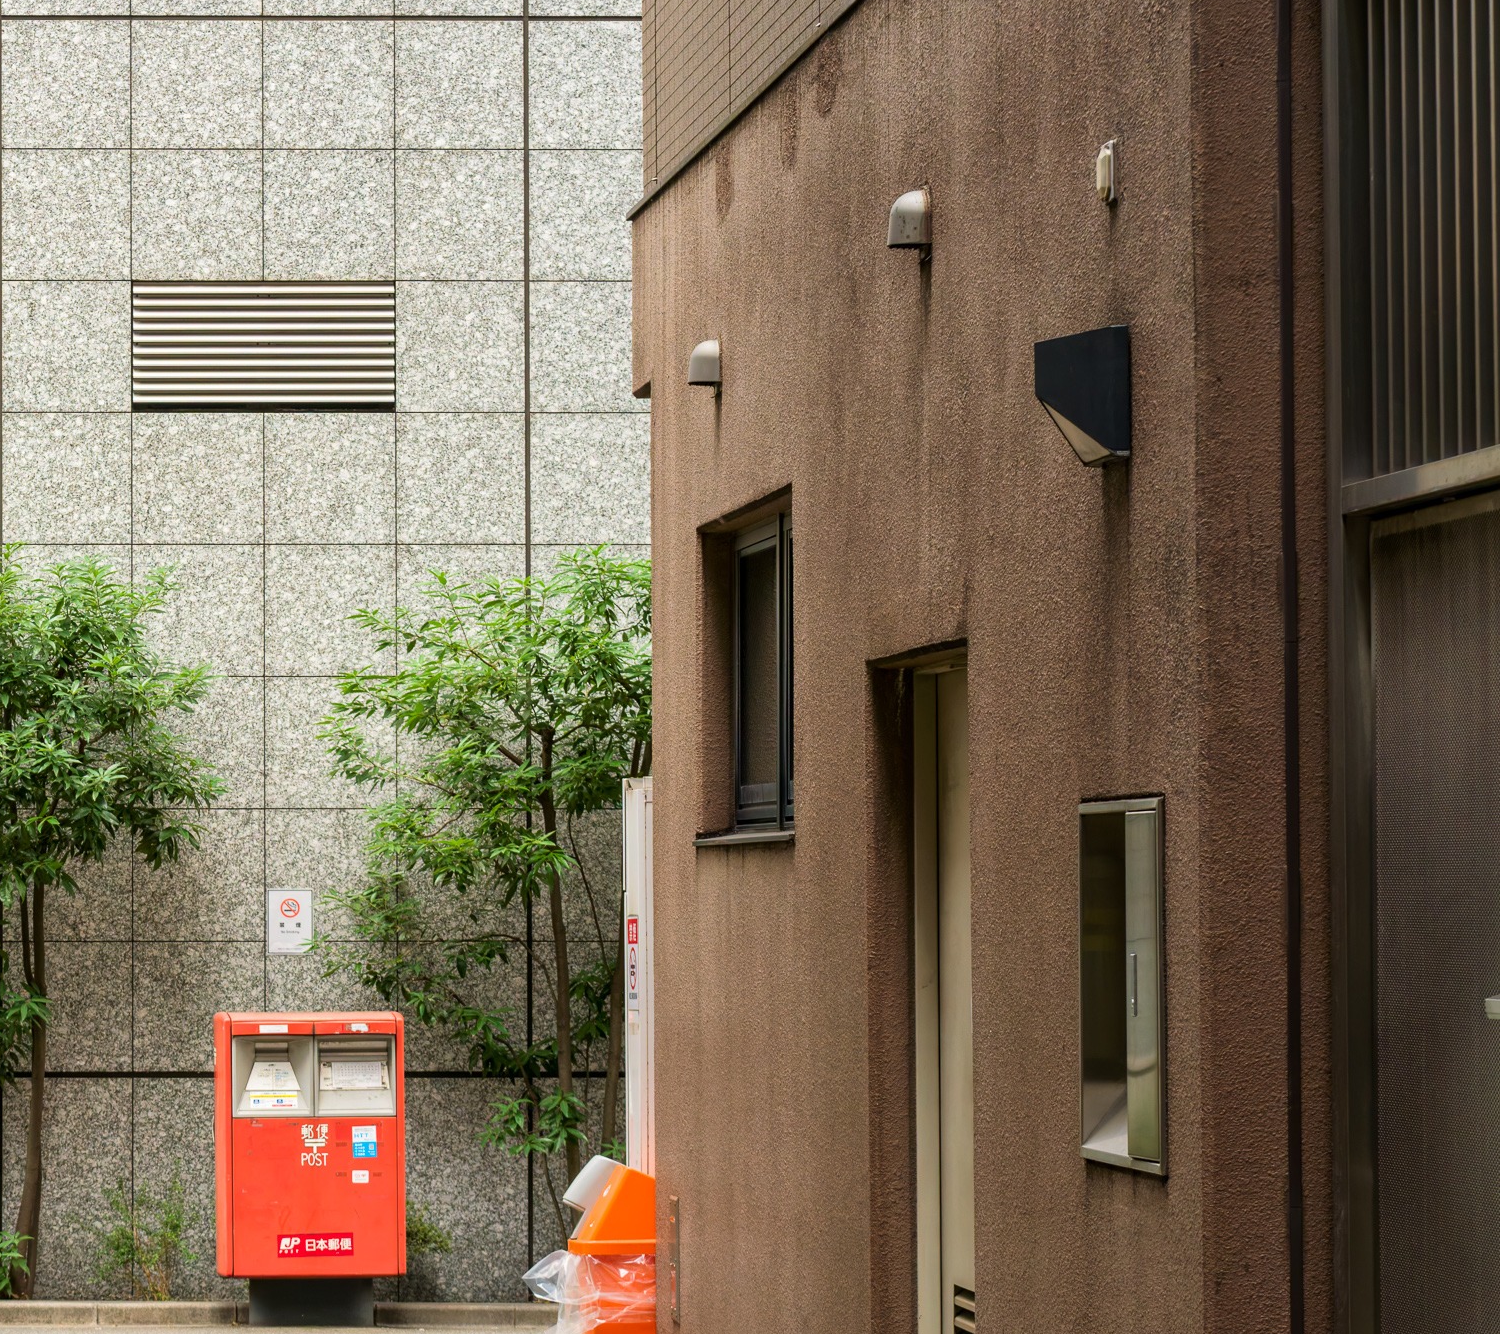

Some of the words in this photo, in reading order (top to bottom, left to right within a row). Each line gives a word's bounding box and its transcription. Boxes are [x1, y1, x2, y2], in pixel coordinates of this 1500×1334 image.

[301, 1123, 329, 1140] 郵便
[301, 1152, 329, 1167] POST
[305, 1238, 352, 1252] 日本郵便
